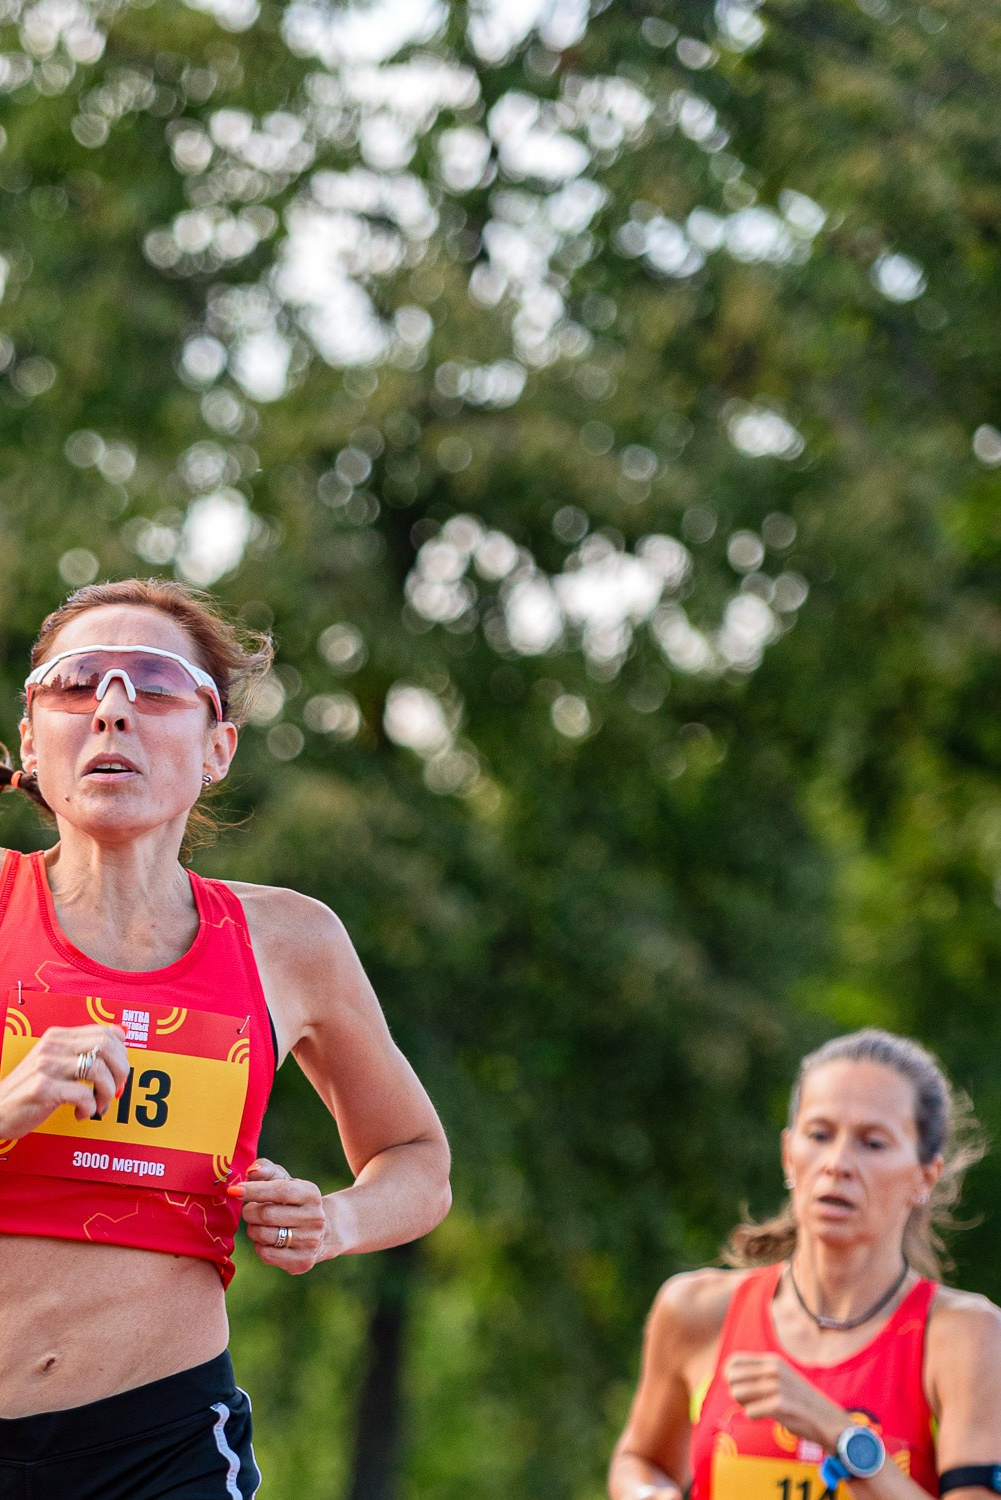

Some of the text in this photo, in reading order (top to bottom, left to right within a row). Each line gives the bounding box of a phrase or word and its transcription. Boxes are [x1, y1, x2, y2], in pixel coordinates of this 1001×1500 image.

[122, 1009, 150, 1024] БИТВА
[125, 1030, 149, 1042] ЛУБОВ
[90, 1066, 172, 1129] 13
[72, 1151, 166, 1177] 3000 метров
